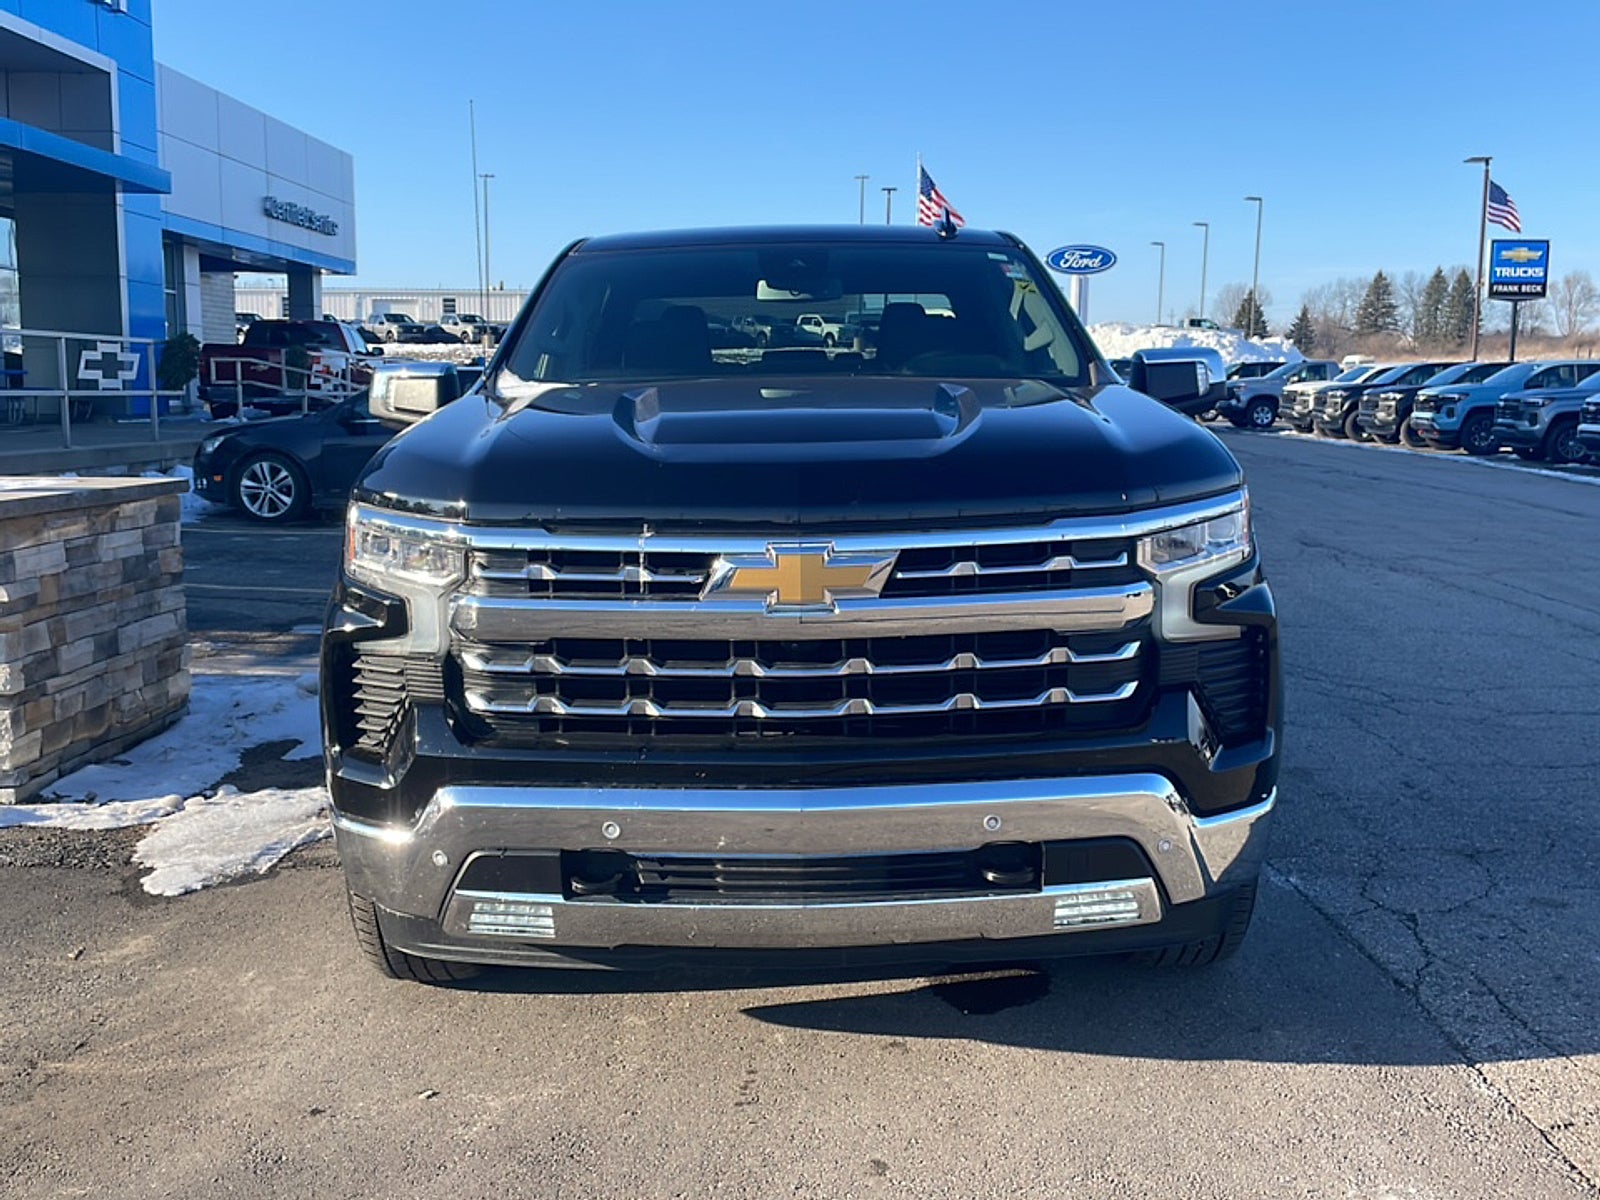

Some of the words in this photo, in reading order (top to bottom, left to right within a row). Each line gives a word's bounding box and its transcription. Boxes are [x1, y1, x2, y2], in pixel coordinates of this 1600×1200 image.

[1060, 251, 1103, 268] Ford
[1495, 267, 1544, 278] TRUCKS
[1493, 285, 1519, 293] FRANK
[1521, 285, 1543, 293] BECK
